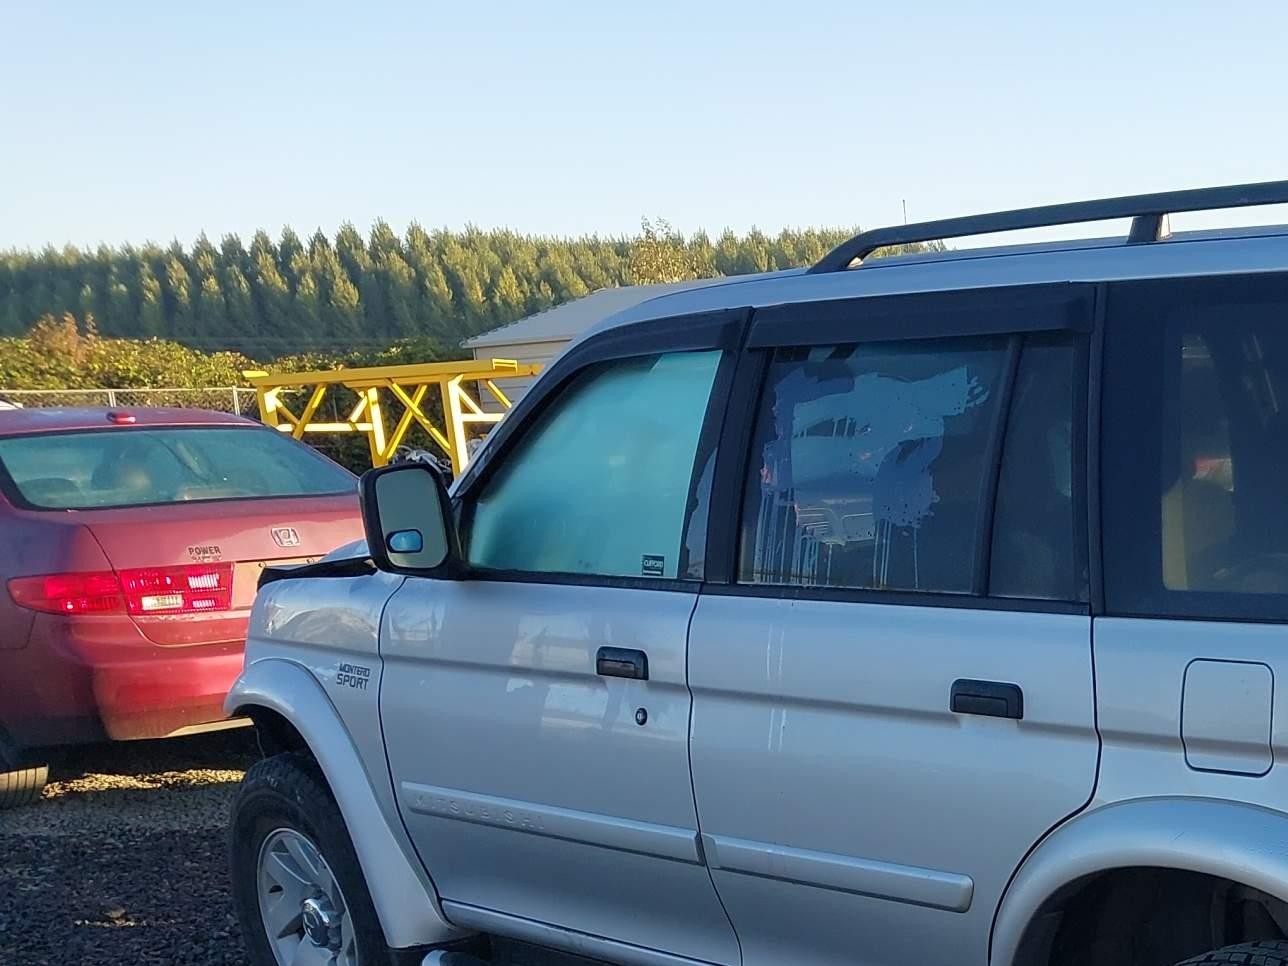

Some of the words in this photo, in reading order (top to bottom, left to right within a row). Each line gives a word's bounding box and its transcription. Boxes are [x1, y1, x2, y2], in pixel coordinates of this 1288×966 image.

[188, 545, 222, 555] POWER
[339, 663, 371, 677] MONTERO
[336, 673, 369, 690] SPORT
